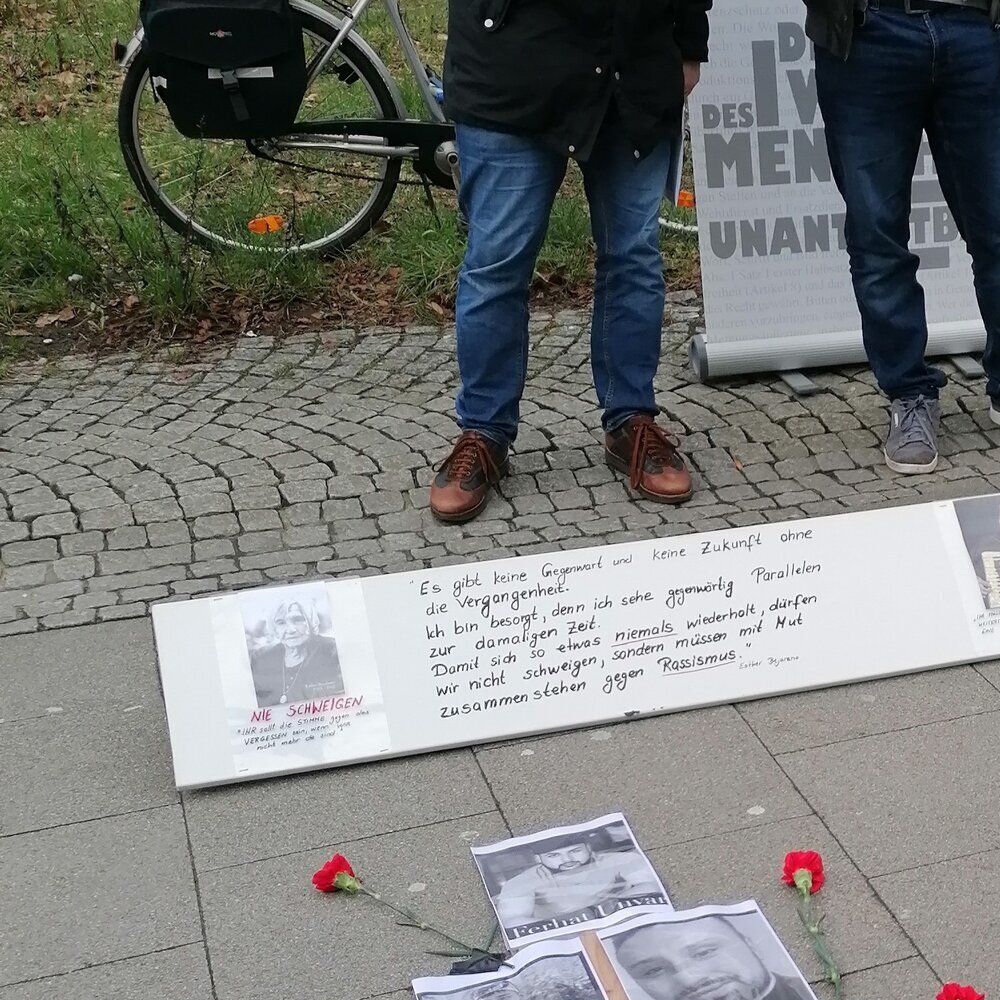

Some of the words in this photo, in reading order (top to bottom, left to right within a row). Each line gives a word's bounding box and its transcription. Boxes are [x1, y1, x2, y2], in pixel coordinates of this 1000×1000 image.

[702, 103, 754, 129] DES
[453, 573, 482, 597] gibt
[494, 571, 527, 585] keine
[542, 556, 603, 585] Gegenwart
[613, 554, 633, 566] und
[652, 548, 686, 561] keine
[701, 533, 762, 555] Zukunft
[780, 528, 813, 543] ohne
[426, 624, 445, 640] Ich
[454, 620, 478, 635] bin
[490, 605, 547, 632] besorgt,
[551, 602, 585, 617] denn
[594, 595, 613, 610] ich
[621, 589, 655, 606] sehe
[751, 560, 821, 584] Parallelen
[426, 603, 448, 616] die
[429, 644, 456, 659] zur
[475, 627, 557, 650] damaligen
[431, 656, 479, 677] Damit
[491, 653, 517, 667] sich
[530, 648, 545, 659] so
[556, 636, 601, 653] etwas
[615, 619, 675, 642] niemals
[769, 593, 817, 612] dürfen
[436, 682, 460, 697] wir
[469, 669, 506, 691] nicht
[612, 641, 664, 660] sondern
[675, 631, 727, 649] müssen
[739, 619, 763, 637] mit
[775, 612, 803, 630] Mut
[602, 667, 644, 693] gegen
[250, 709, 272, 723] NIE
[286, 695, 363, 718] SCHWEIGEN
[244, 731, 288, 746] VERGESSEN
[512, 912, 591, 939] Ferhat
